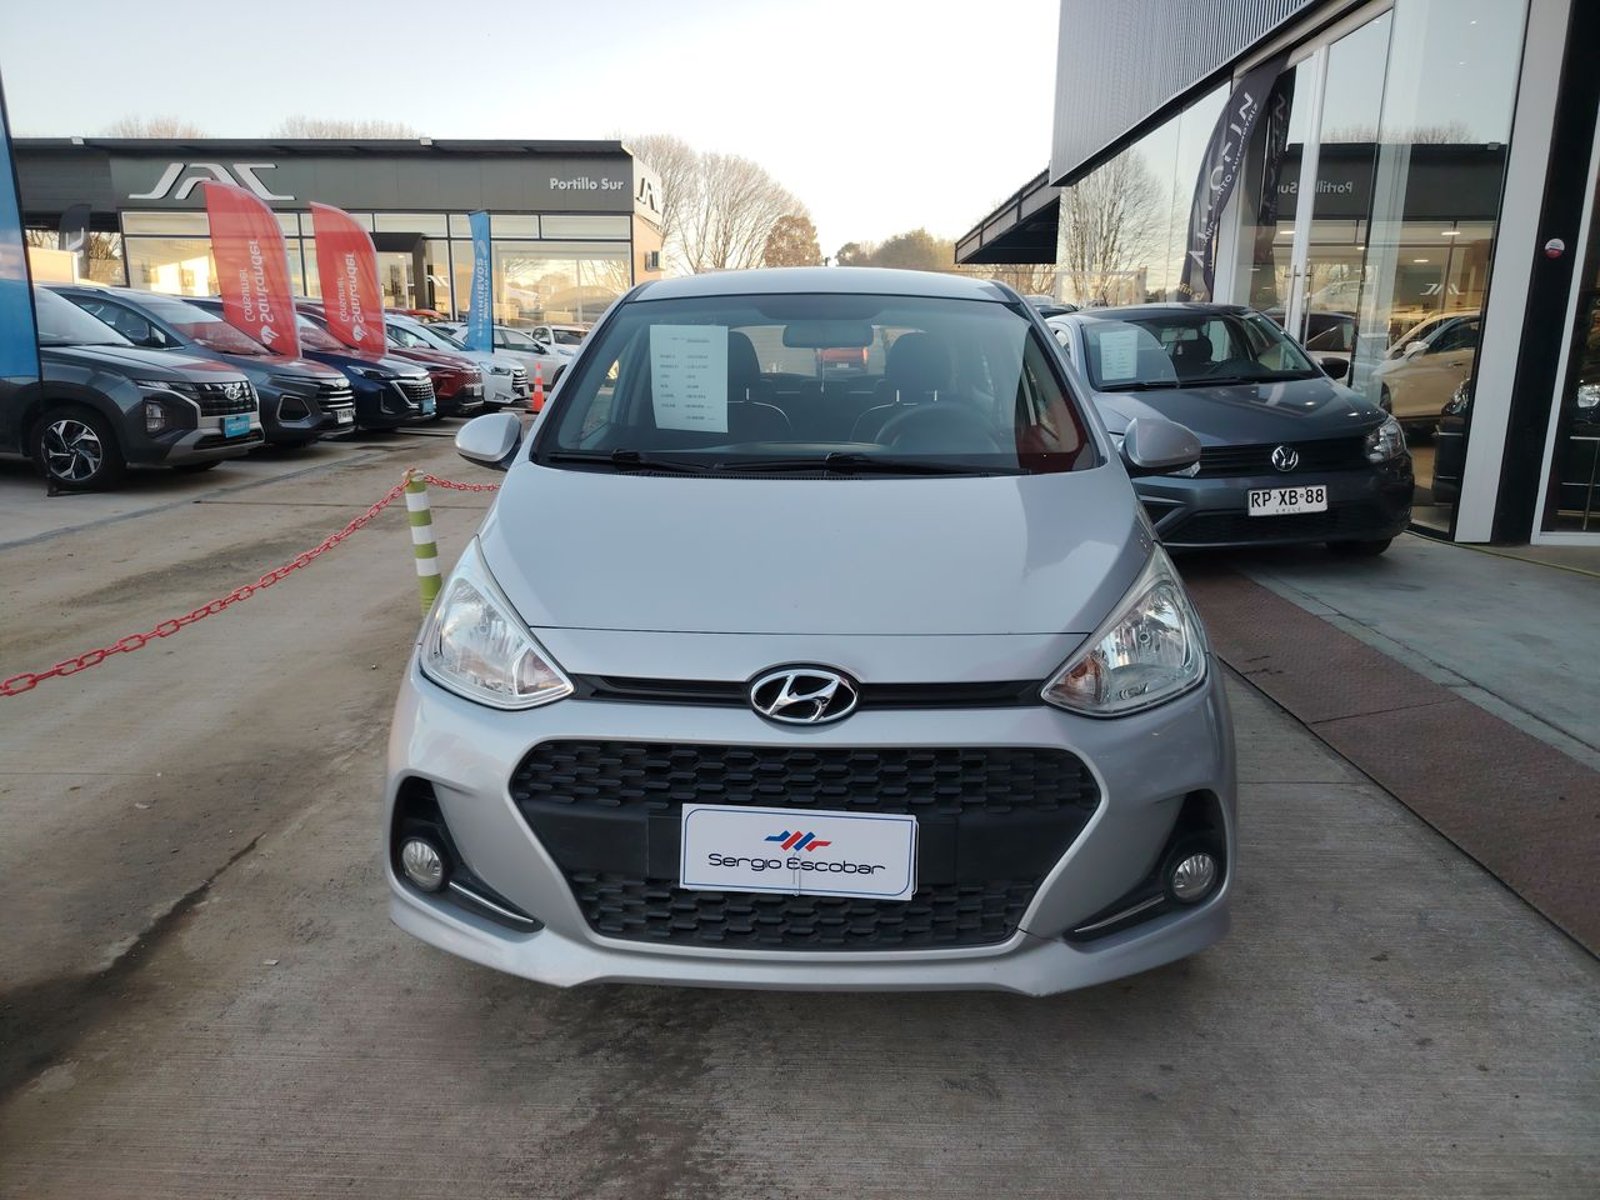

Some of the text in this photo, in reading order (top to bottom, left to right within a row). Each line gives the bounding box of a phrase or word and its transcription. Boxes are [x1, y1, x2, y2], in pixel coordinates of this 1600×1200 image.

[128, 163, 295, 200] JAC
[550, 177, 624, 190] Portillo Sur
[708, 853, 886, 875] Sergio Escobar
